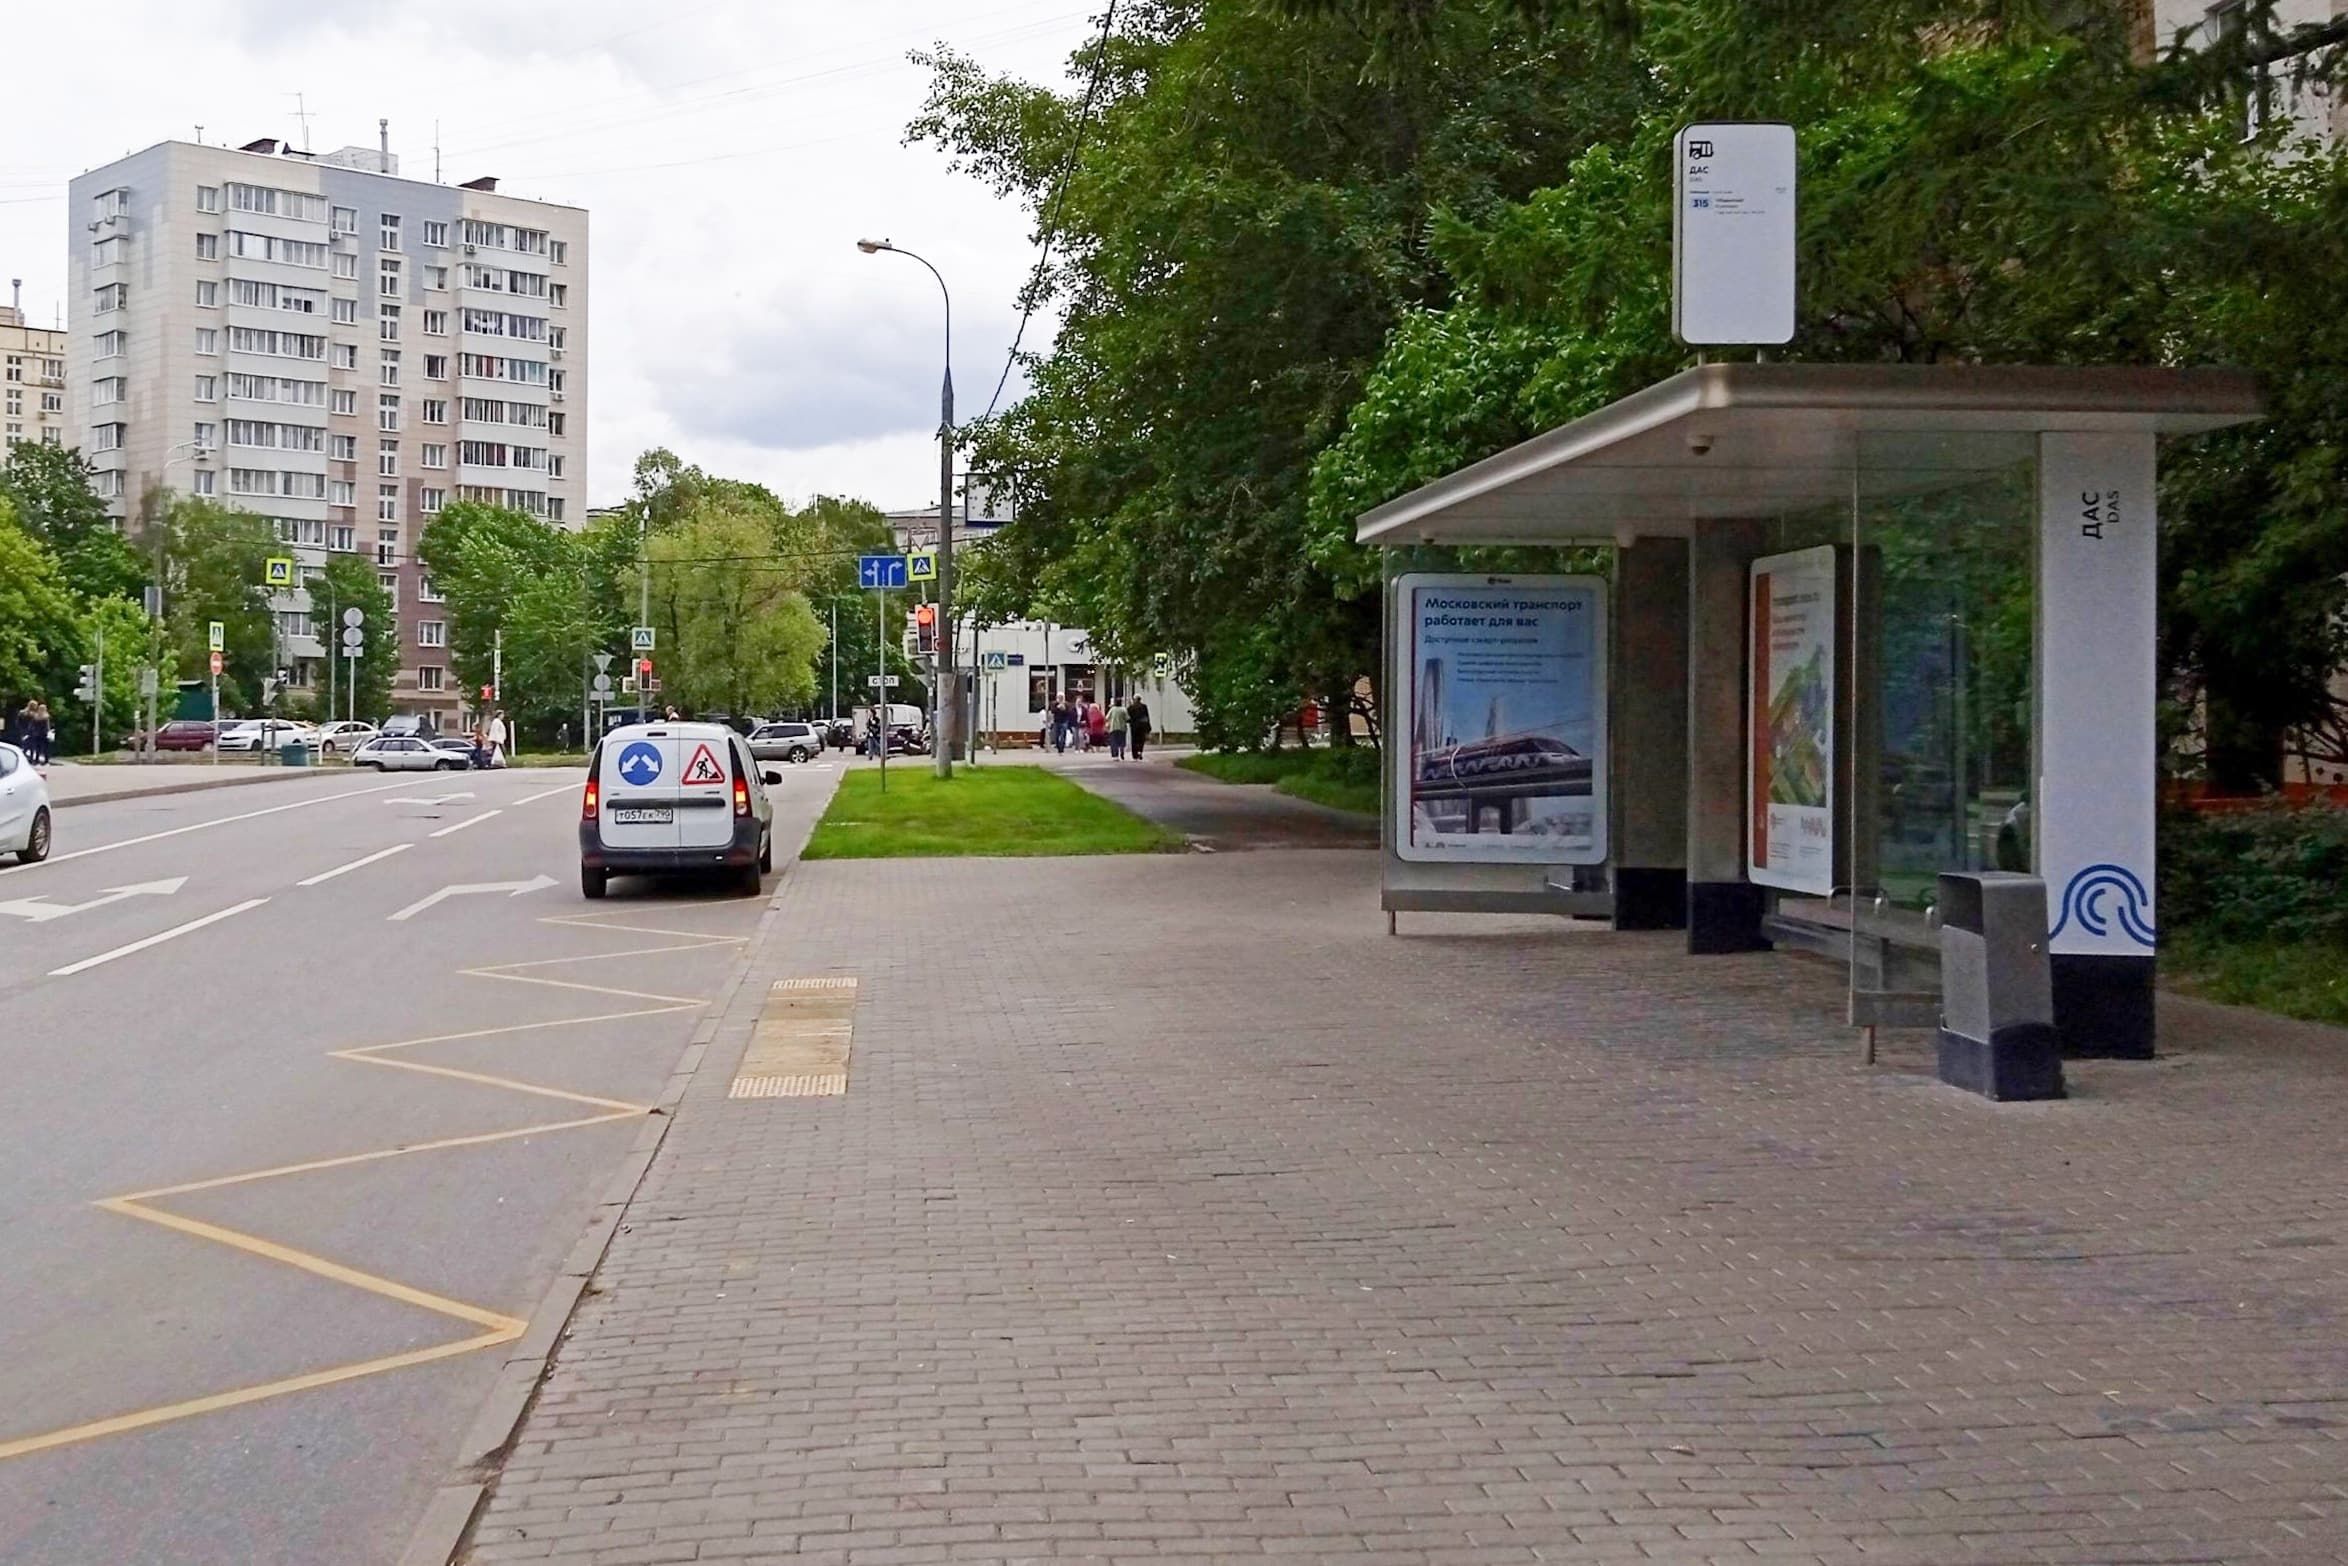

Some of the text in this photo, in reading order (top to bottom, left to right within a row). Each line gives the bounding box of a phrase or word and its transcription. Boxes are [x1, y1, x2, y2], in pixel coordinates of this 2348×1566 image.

[1689, 166, 1709, 175] ДАС
[1692, 199, 1709, 208] 315
[2107, 490, 2120, 523] DAS
[2082, 491, 2103, 540] ДАС
[1425, 598, 1583, 611] Московский транспорт
[1424, 614, 1539, 627] работает для вас
[872, 677, 895, 685] СОП
